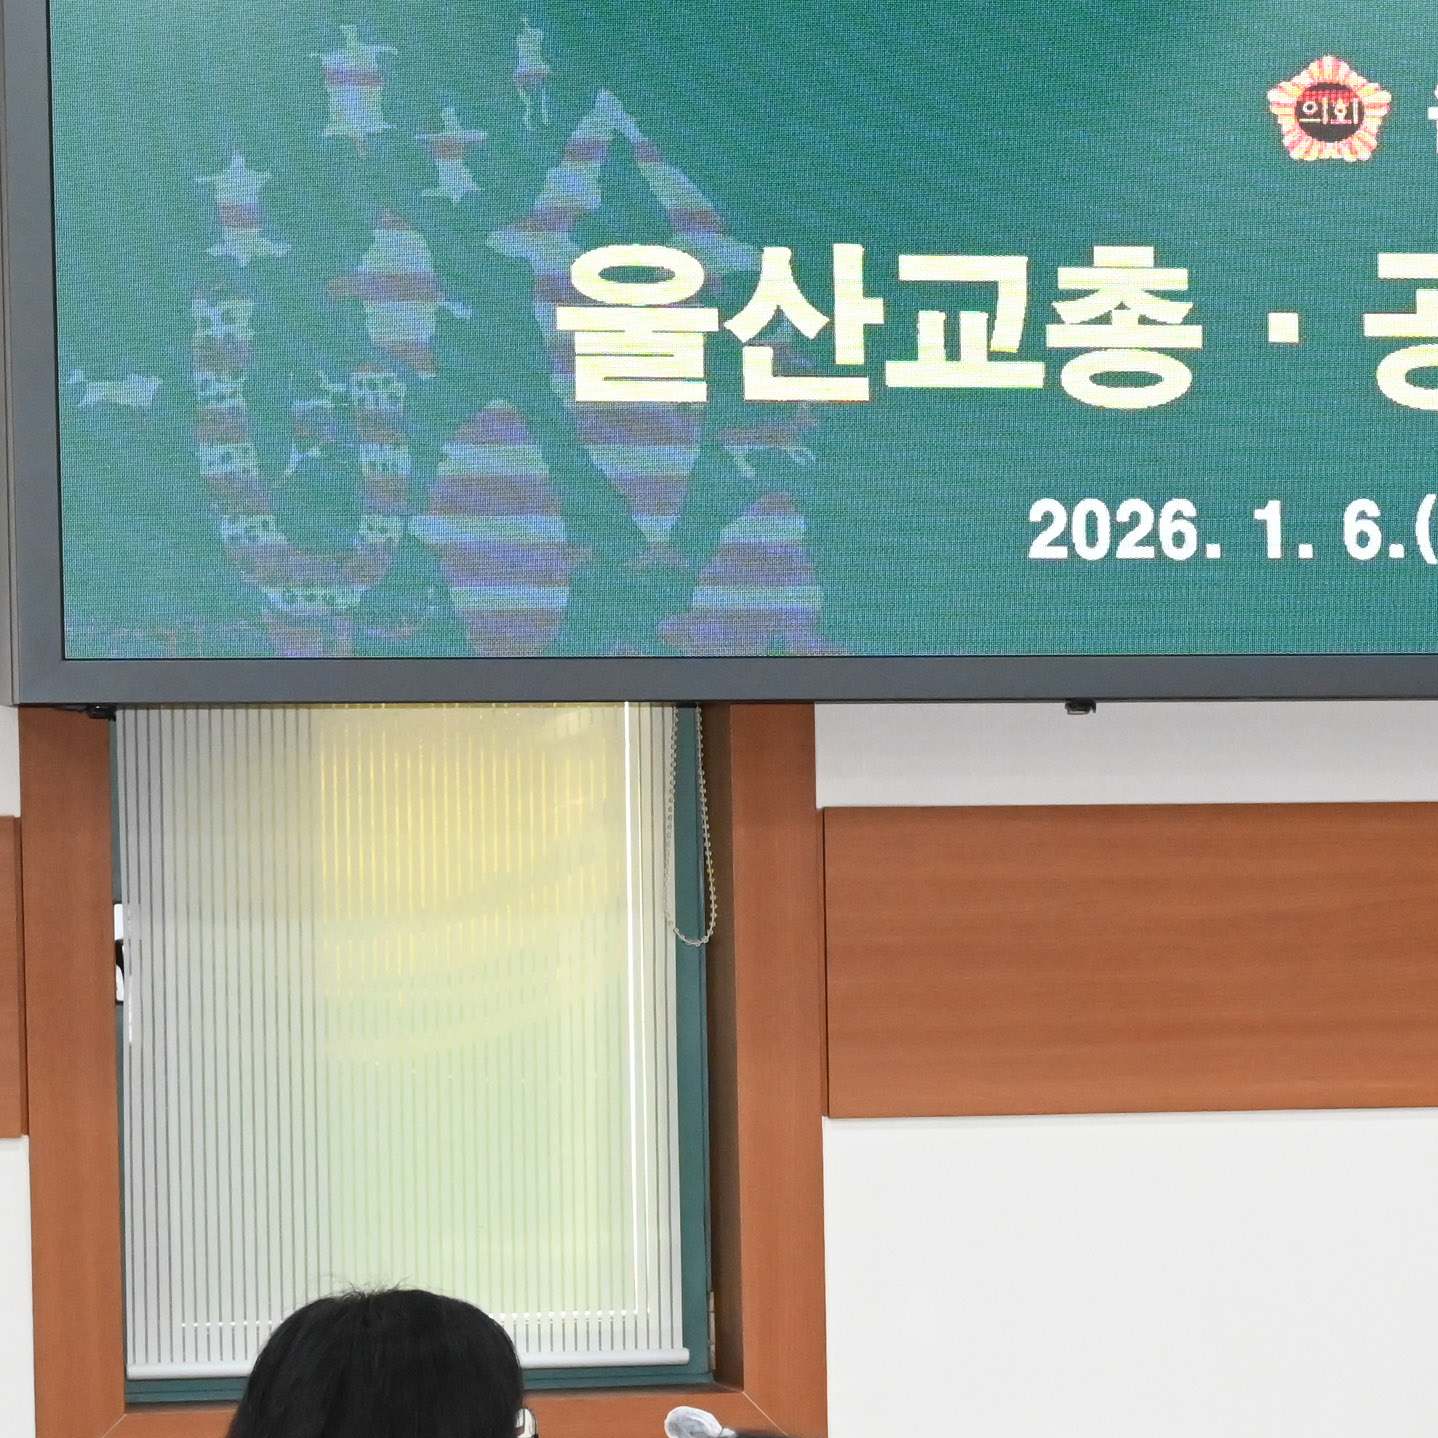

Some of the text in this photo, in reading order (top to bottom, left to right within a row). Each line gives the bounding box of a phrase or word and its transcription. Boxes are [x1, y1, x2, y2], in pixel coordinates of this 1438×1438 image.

[1299, 95, 1360, 127] 의회
[556, 244, 1202, 409] 울산교총
[1029, 498, 1222, 560] 2026.
[1254, 501, 1314, 559] 1.
